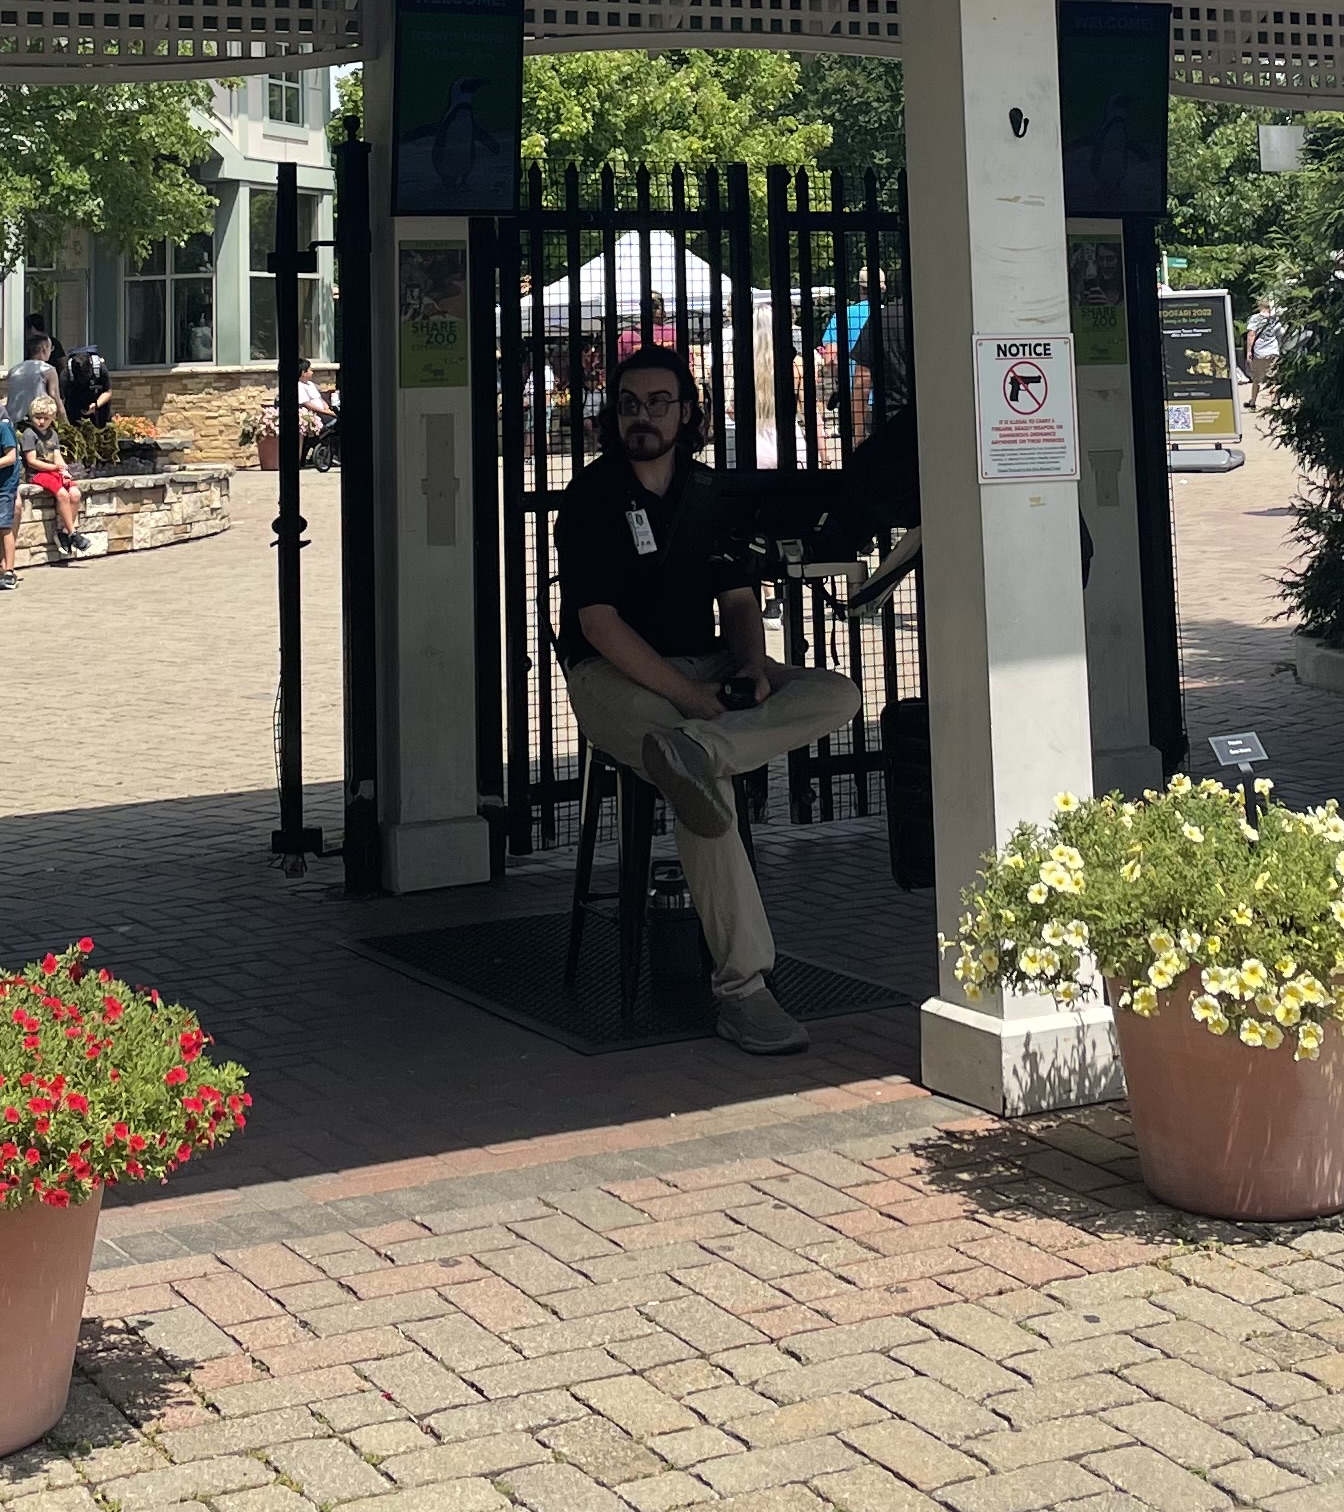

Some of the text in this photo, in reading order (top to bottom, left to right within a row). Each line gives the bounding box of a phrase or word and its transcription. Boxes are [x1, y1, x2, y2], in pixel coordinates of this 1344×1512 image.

[1081, 307, 1117, 318] SHARE
[412, 321, 457, 333] SHARE
[1092, 317, 1117, 327] ZOO
[425, 333, 457, 345] ZOO
[996, 343, 1052, 357] NOTICE
